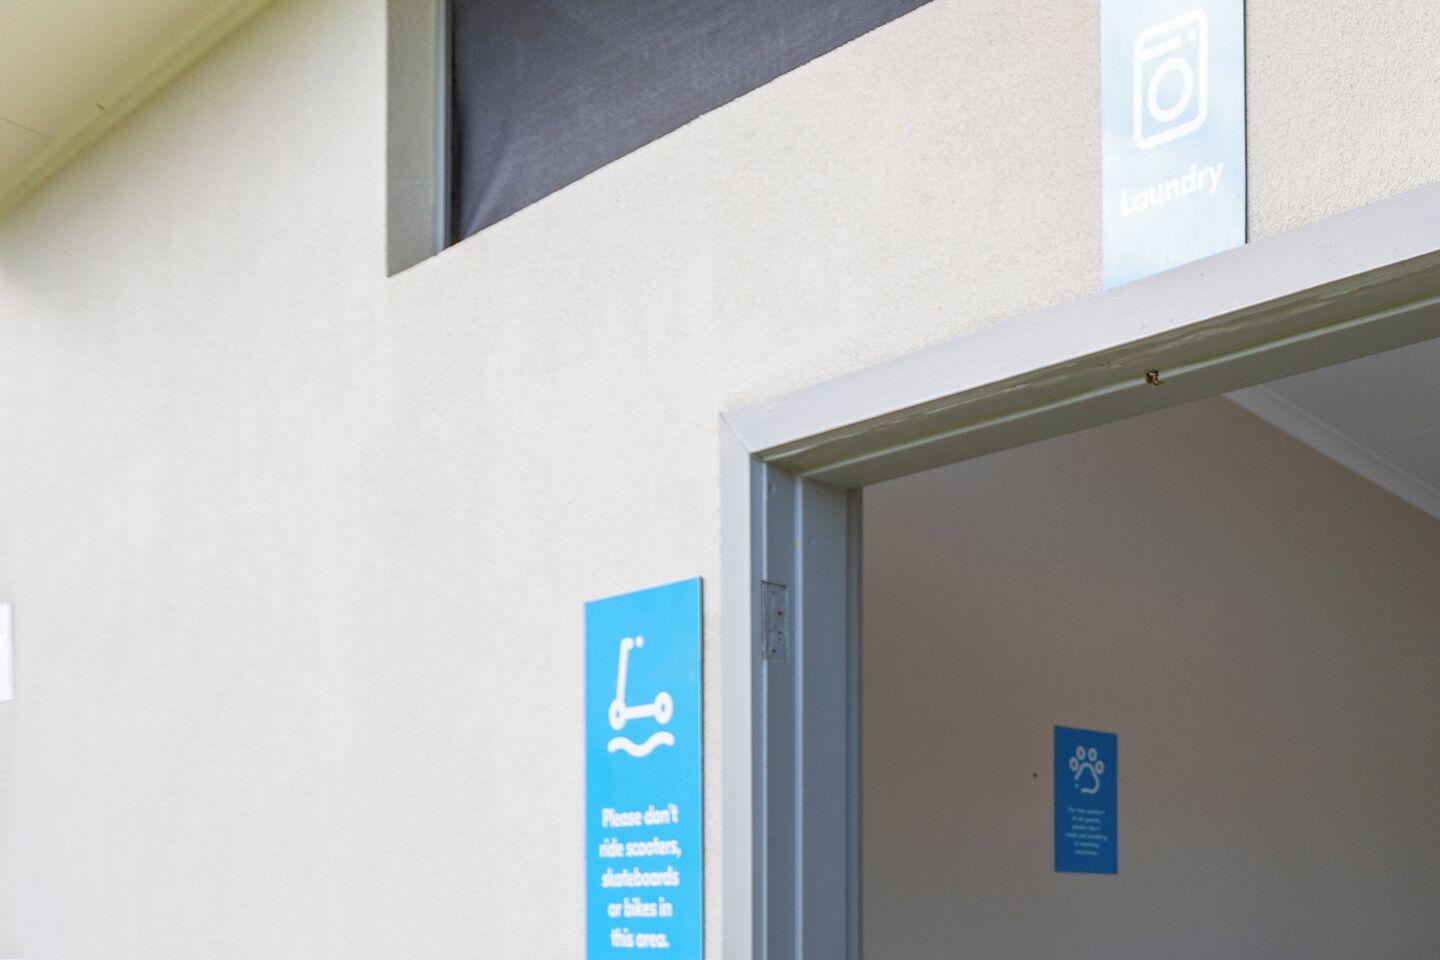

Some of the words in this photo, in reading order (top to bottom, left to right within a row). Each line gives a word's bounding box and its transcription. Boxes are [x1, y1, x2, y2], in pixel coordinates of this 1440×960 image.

[1120, 161, 1224, 216] Laundry
[601, 807, 642, 828] Please
[644, 803, 679, 826] don't
[599, 838, 624, 858] ride
[626, 837, 682, 859] scooters,
[601, 866, 680, 888] skateboards
[607, 902, 622, 918] or
[623, 897, 657, 918] bikes
[659, 897, 673, 918] in
[610, 927, 634, 949] this
